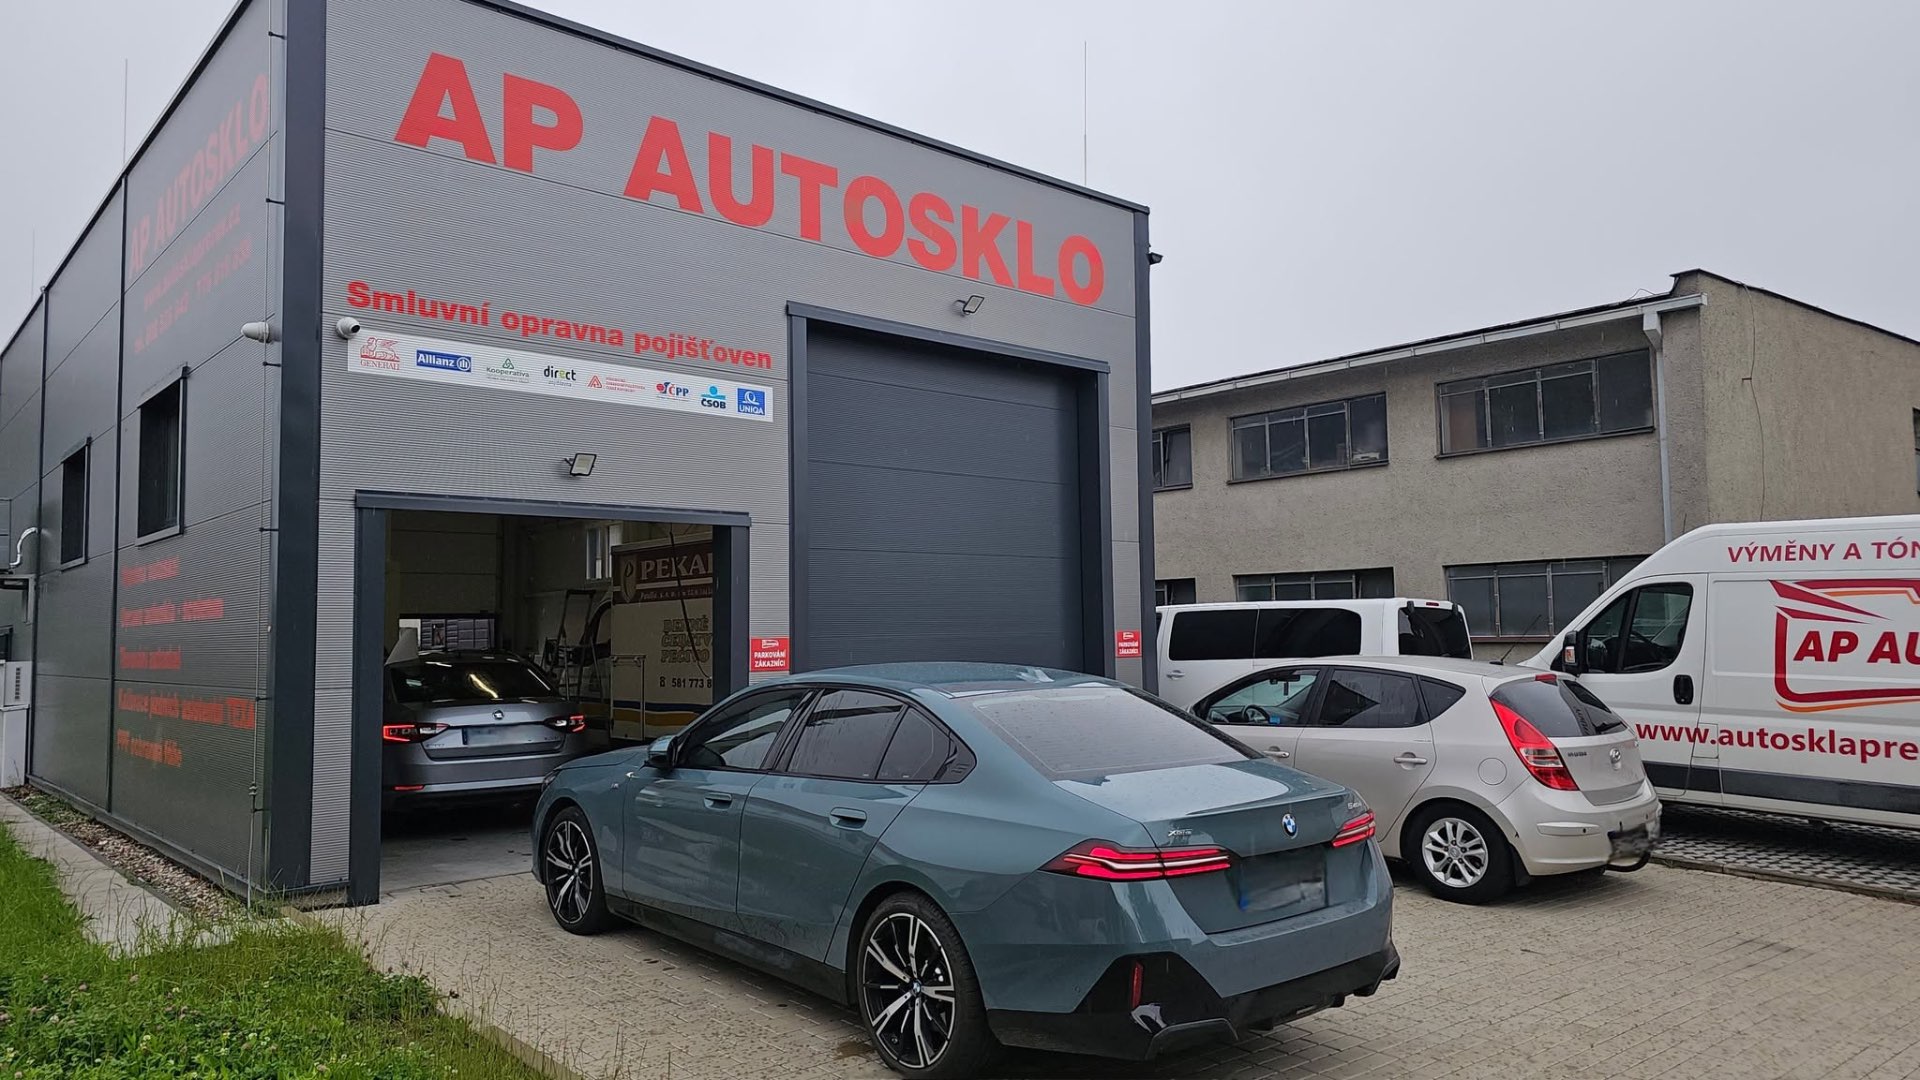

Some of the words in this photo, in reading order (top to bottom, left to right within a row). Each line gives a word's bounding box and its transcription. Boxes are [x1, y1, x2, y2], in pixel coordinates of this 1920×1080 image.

[128, 213, 150, 279] AP
[154, 73, 268, 246] AUTOSKLO
[394, 52, 583, 173] AP
[623, 115, 1105, 306] AUTOSKLO
[346, 280, 491, 326] Smluvní
[501, 311, 624, 347] opravna
[633, 332, 772, 370] pojišťoven
[417, 353, 455, 367] Allianz
[486, 367, 530, 378] Kooperativa
[543, 365, 577, 381] direct
[668, 383, 690, 397] ČPP
[700, 399, 727, 409] ČSOB
[739, 405, 764, 415] UNIQA
[1728, 539, 1836, 563] VÝMĚNY
[1843, 542, 1862, 560] A
[1793, 630, 1859, 663] AP
[671, 678, 686, 688] 581
[689, 679, 705, 689] 773
[1635, 723, 1919, 764] www.autosklapre
